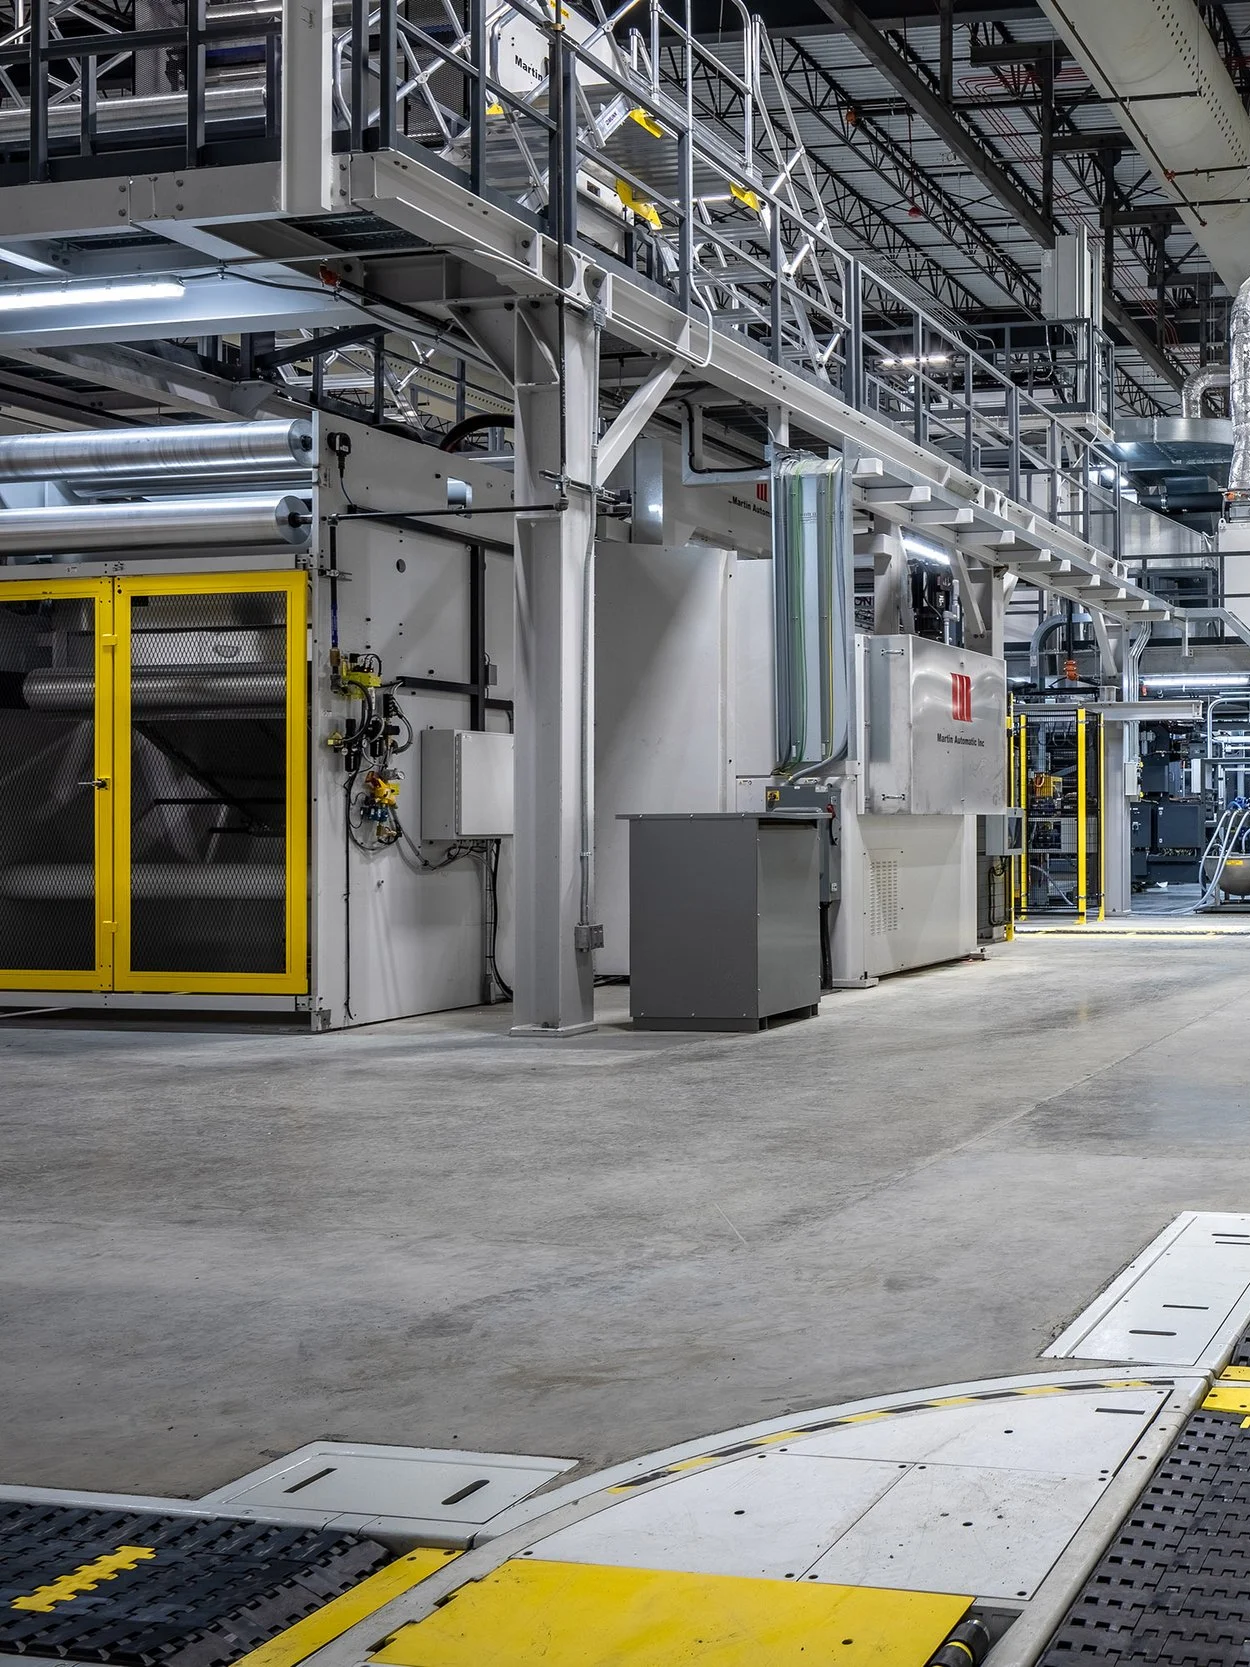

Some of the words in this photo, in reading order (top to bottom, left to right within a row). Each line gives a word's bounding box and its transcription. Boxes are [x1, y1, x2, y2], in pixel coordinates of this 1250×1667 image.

[515, 54, 543, 82] Martin
[732, 496, 751, 511] Martin
[752, 504, 772, 518] Autom
[937, 733, 953, 743] Martin
